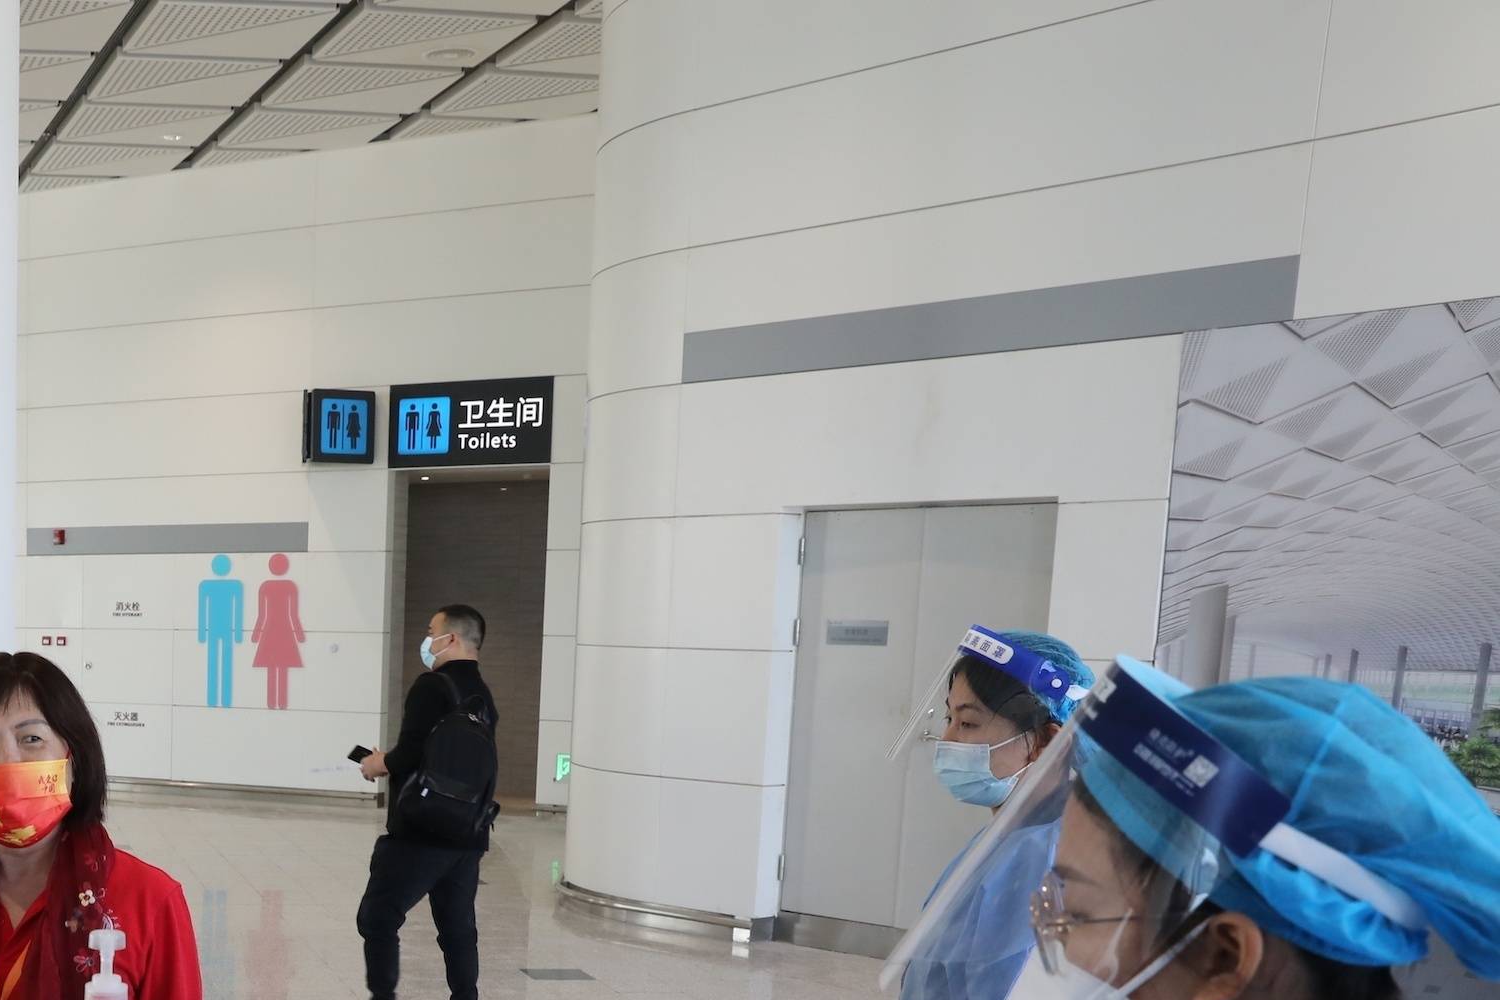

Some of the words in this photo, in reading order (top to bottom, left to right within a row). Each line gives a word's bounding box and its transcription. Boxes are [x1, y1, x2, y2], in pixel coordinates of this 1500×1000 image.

[458, 397, 544, 429] 卫生间
[458, 432, 517, 450] Toilets
[115, 601, 140, 611] 消火栓
[114, 711, 138, 721] 灭火器
